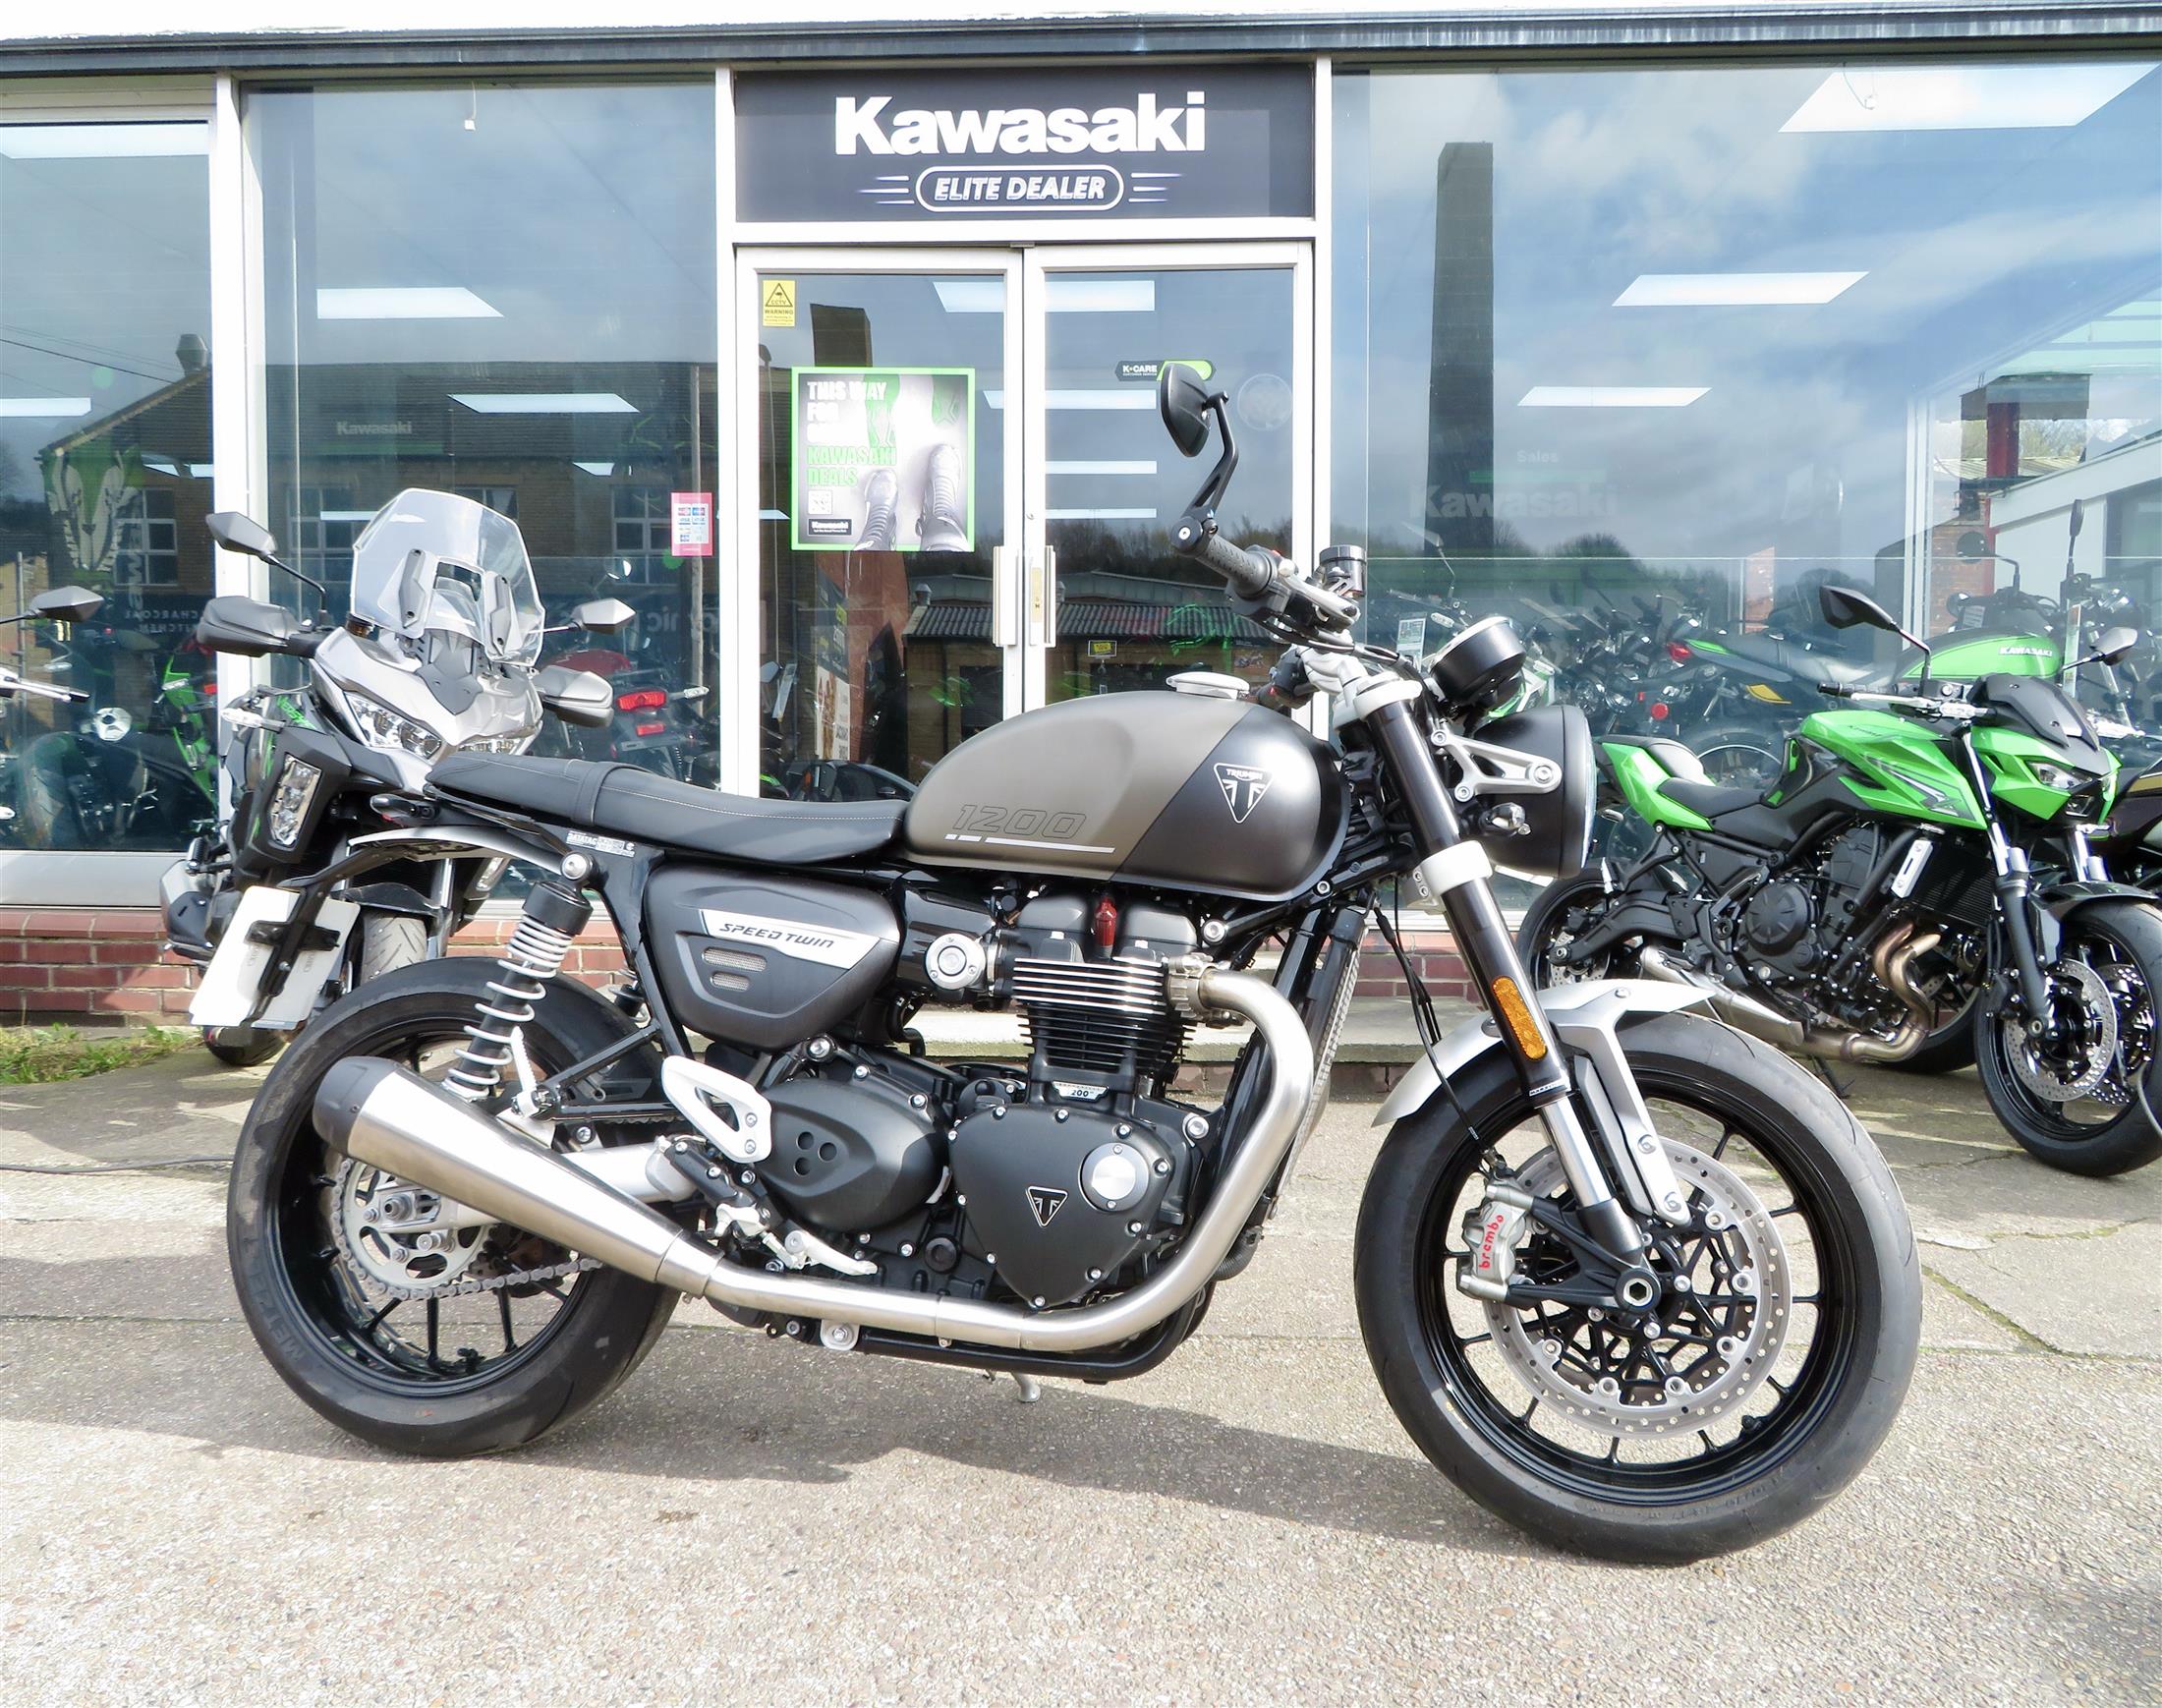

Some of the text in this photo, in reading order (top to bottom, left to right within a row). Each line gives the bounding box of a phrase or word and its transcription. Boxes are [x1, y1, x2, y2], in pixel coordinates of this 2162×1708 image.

[835, 90, 1206, 155] Kawasaki
[935, 175, 1107, 201] ELITE DEALER
[807, 381, 886, 401] THIS WAY
[336, 421, 413, 435] Kawasaki
[807, 445, 897, 466] KAWASAKI
[1516, 450, 1560, 463] Sales
[807, 467, 858, 487] DEALS
[1410, 484, 1618, 518] Kawasaki
[1999, 646, 2053, 657] KAWASAKI
[951, 804, 1087, 839] 1200
[719, 923, 834, 948] SPEED TWIN
[1478, 1214, 1505, 1270] brembo
